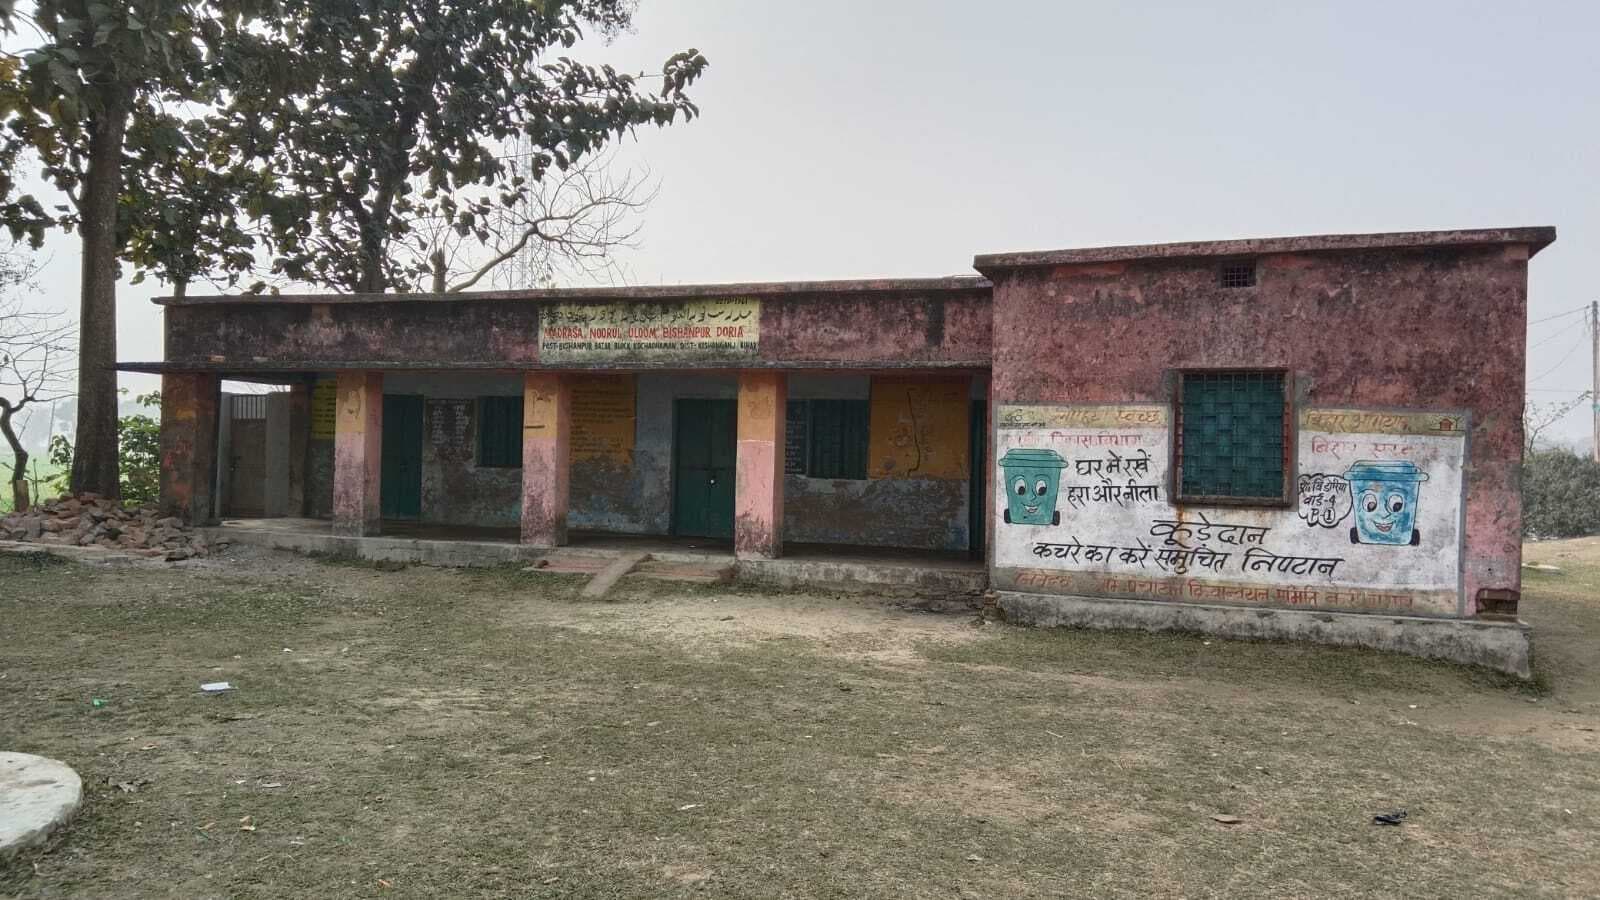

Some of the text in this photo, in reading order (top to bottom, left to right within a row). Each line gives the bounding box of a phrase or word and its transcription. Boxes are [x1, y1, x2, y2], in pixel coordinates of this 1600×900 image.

[662, 327, 711, 338] BISHANPUR
[716, 326, 744, 338] DORIA
[1075, 449, 1152, 479] घर में रखें
[1067, 478, 1159, 510] हरा और नीला
[1032, 536, 1083, 564] कचरे
[1084, 544, 1117, 563] का
[1119, 537, 1153, 568] करें
